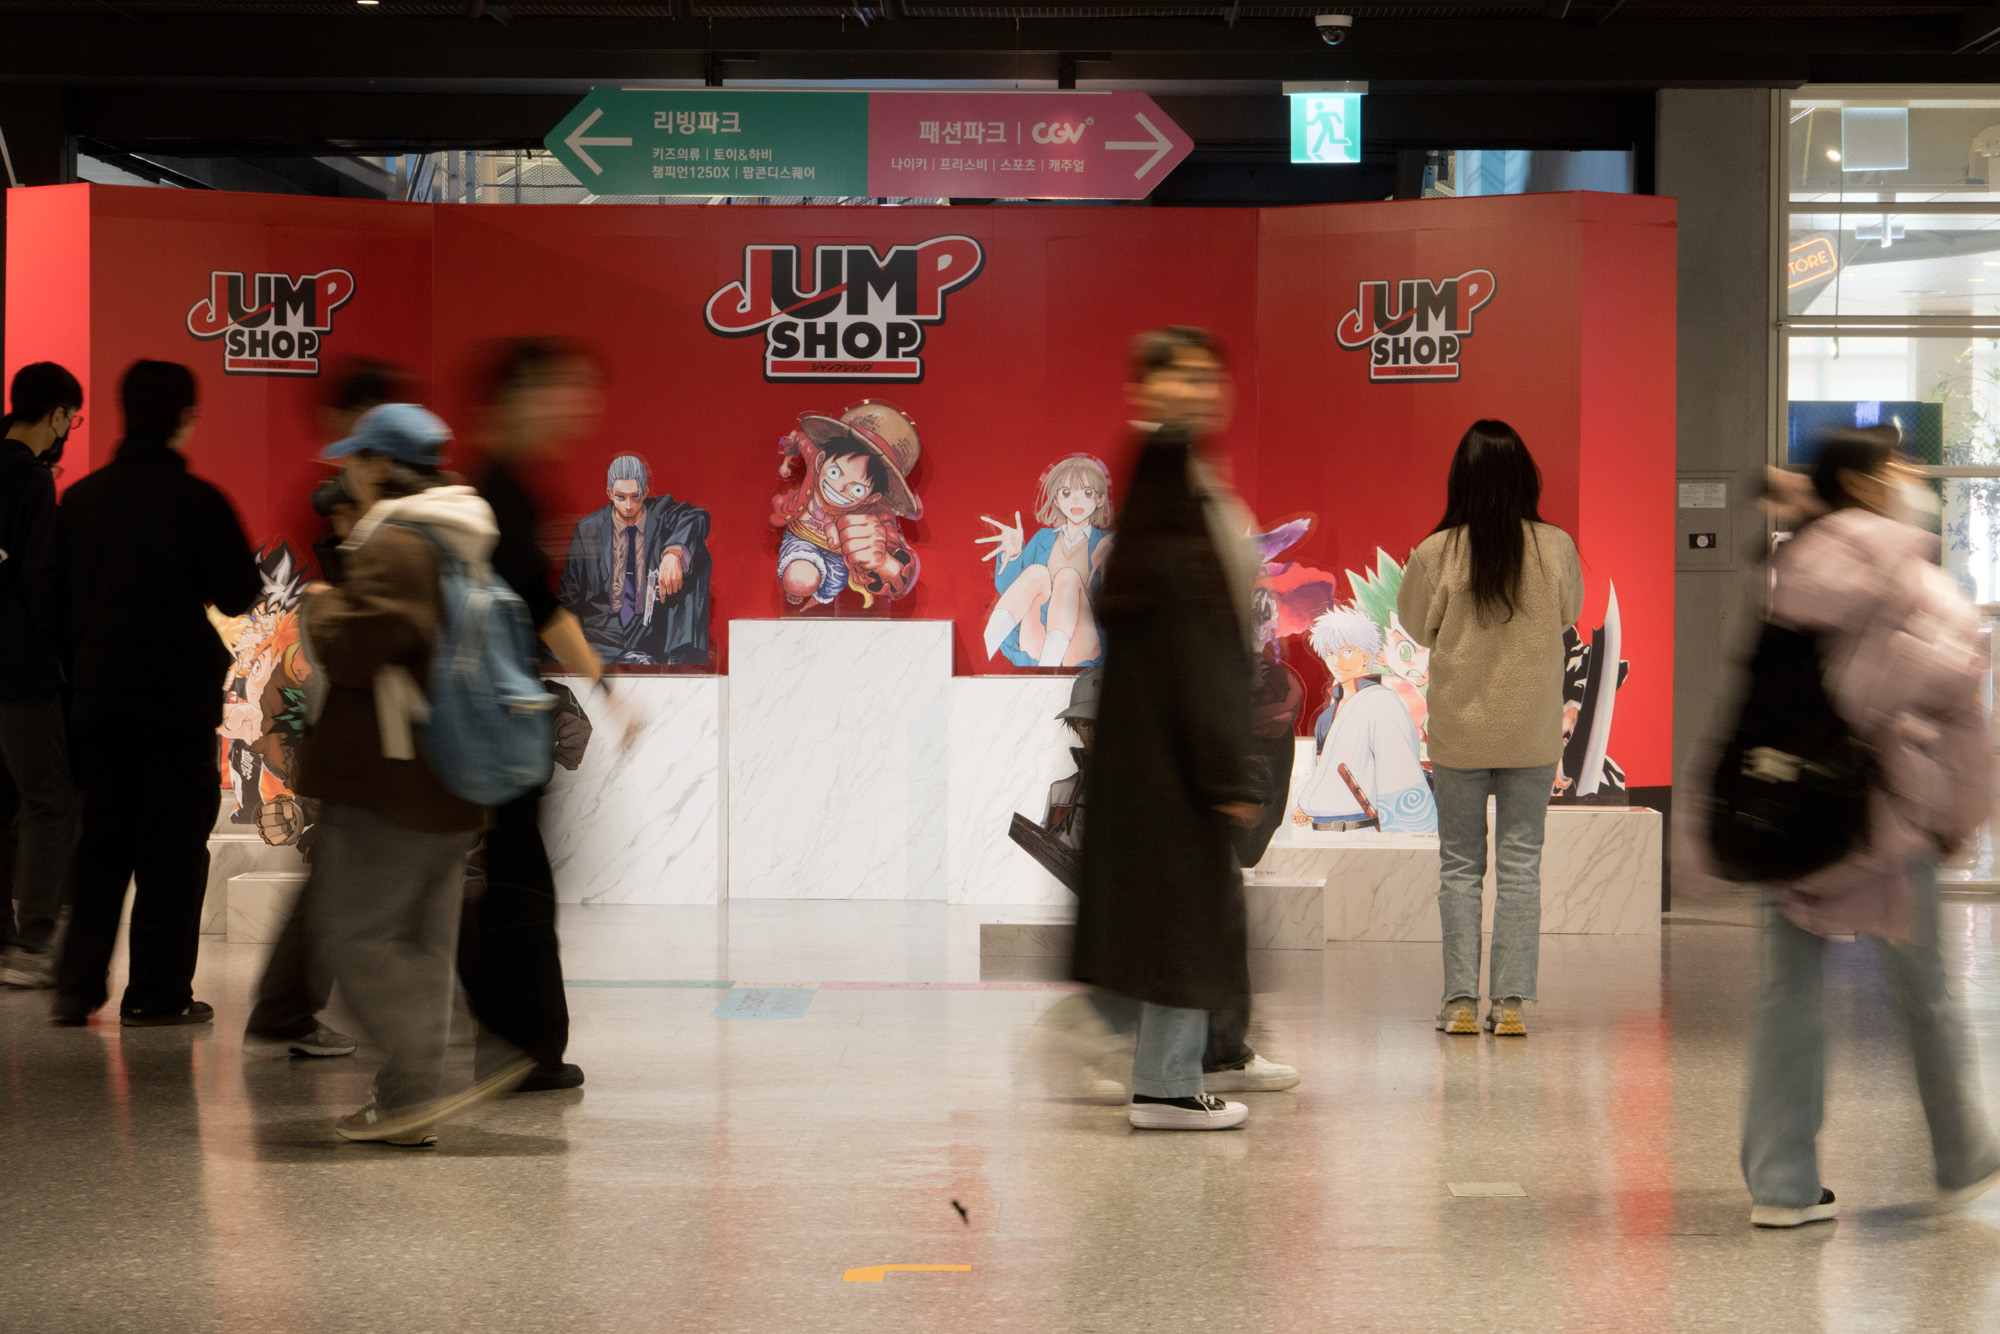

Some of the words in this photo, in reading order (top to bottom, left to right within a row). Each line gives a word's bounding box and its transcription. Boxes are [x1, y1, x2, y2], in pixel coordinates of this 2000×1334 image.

[653, 110, 742, 135] 리빙파크
[919, 121, 1007, 145] 패션파크
[1031, 122, 1086, 145] CGV
[652, 147, 701, 161] 키즈의류
[713, 148, 773, 162] 토이&하비
[891, 157, 928, 172] 나이키
[939, 158, 988, 172] 프리스비
[1000, 158, 1036, 172] 스포츠
[1048, 159, 1085, 173] 캐주얼
[652, 165, 730, 179] 챔피언1250X
[705, 234, 983, 334] JUMP
[187, 269, 354, 337] JUMP
[1336, 269, 1496, 347] JUMP
[227, 328, 318, 360] SHOP
[769, 320, 920, 359] SHOP
[1373, 335, 1459, 366] SHOP
